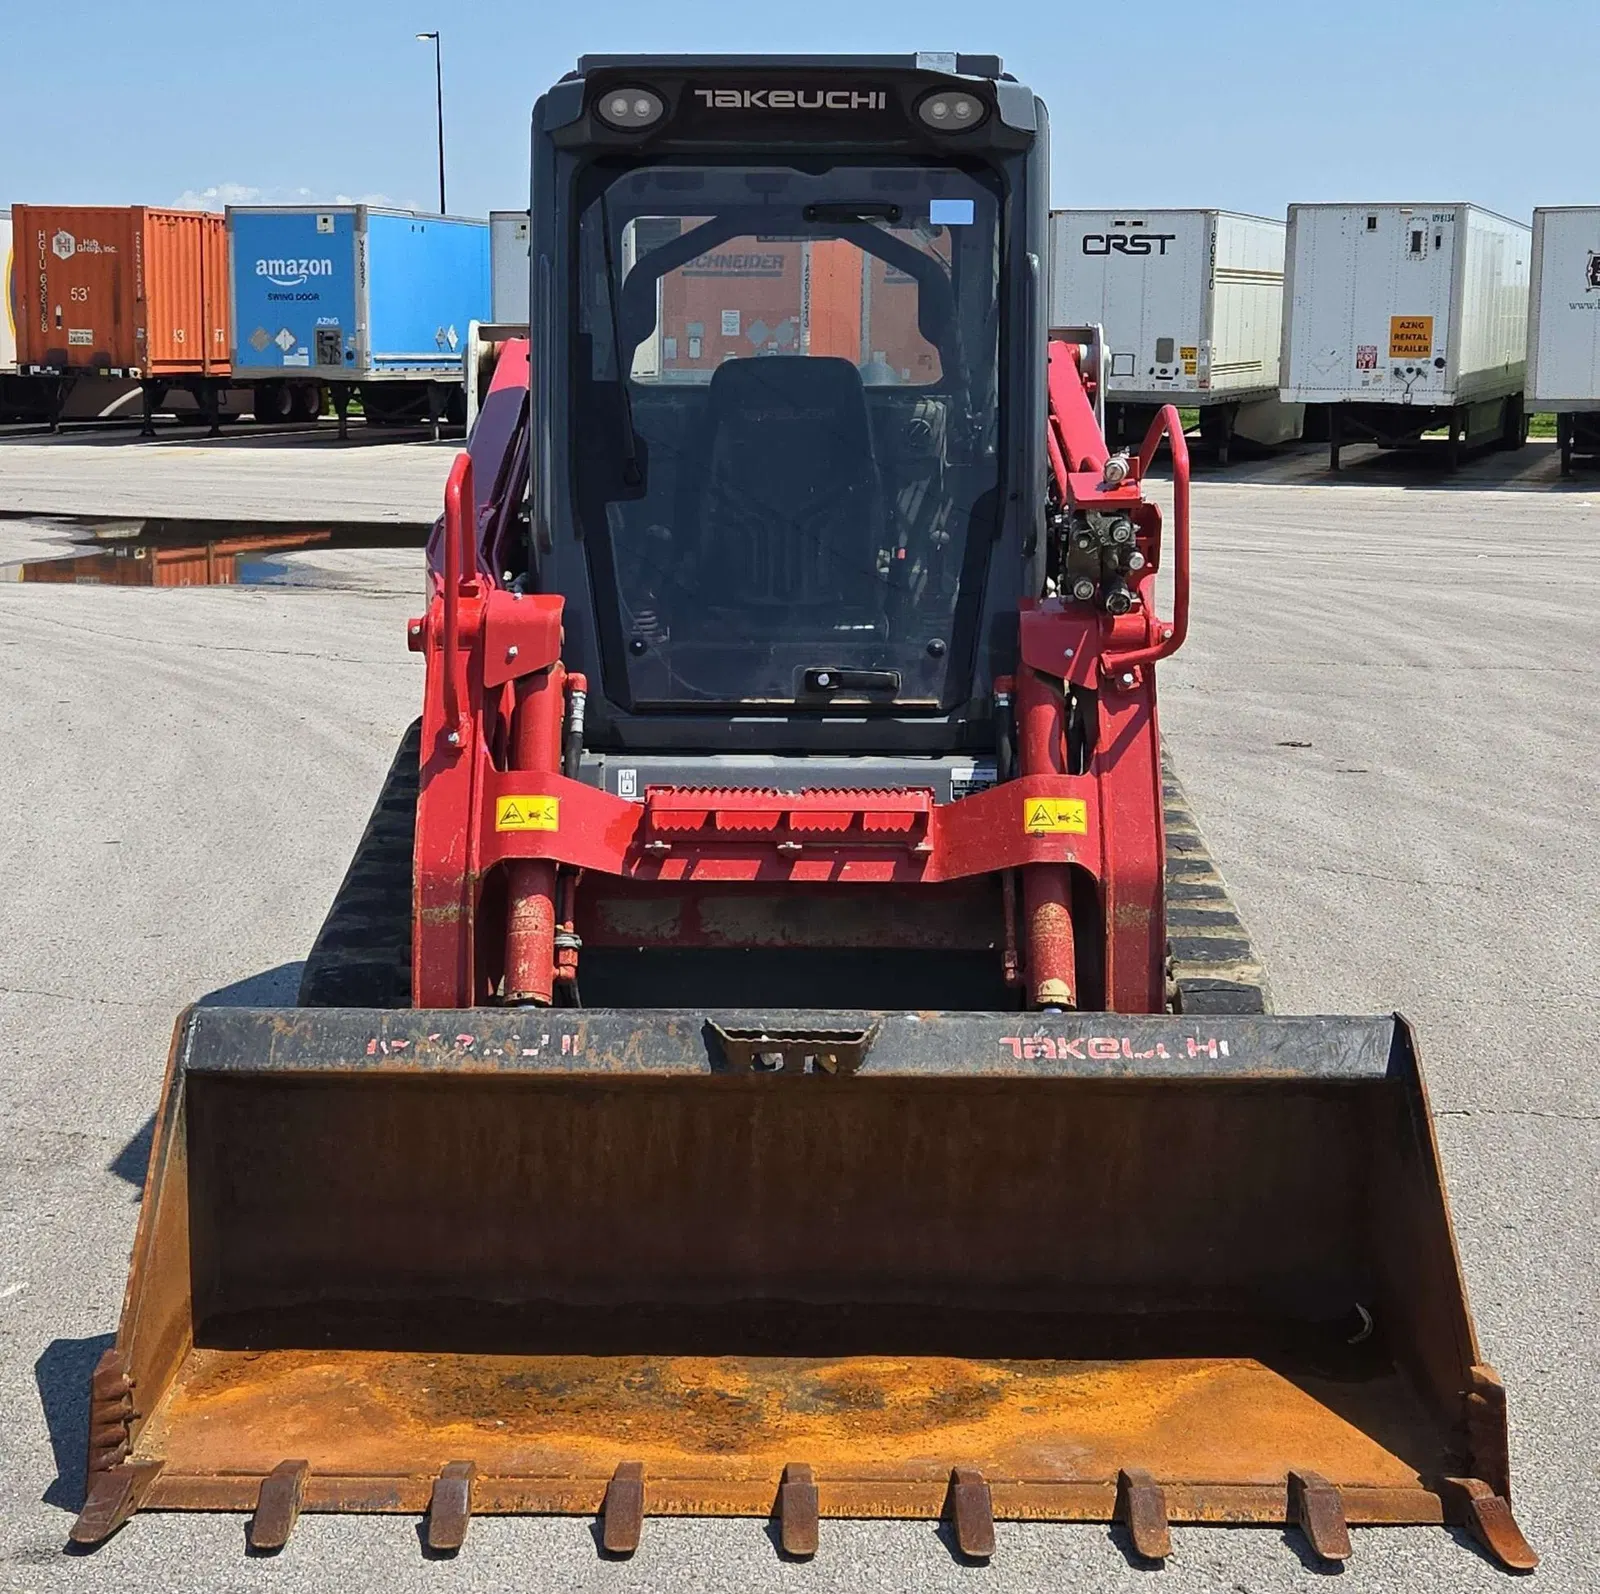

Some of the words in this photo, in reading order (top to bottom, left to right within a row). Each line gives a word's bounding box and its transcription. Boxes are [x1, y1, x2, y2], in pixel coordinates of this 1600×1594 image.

[694, 89, 886, 110] TAKEUCHI
[1082, 234, 1176, 255] CRST
[255, 259, 333, 276] amazon
[267, 292, 294, 301] SWING
[295, 292, 321, 301] DOOR
[1399, 321, 1425, 329] AZNG
[1393, 333, 1428, 341] RENTAL
[1391, 344, 1430, 353] TRAILER
[999, 1036, 1231, 1060] TAKEUHI
